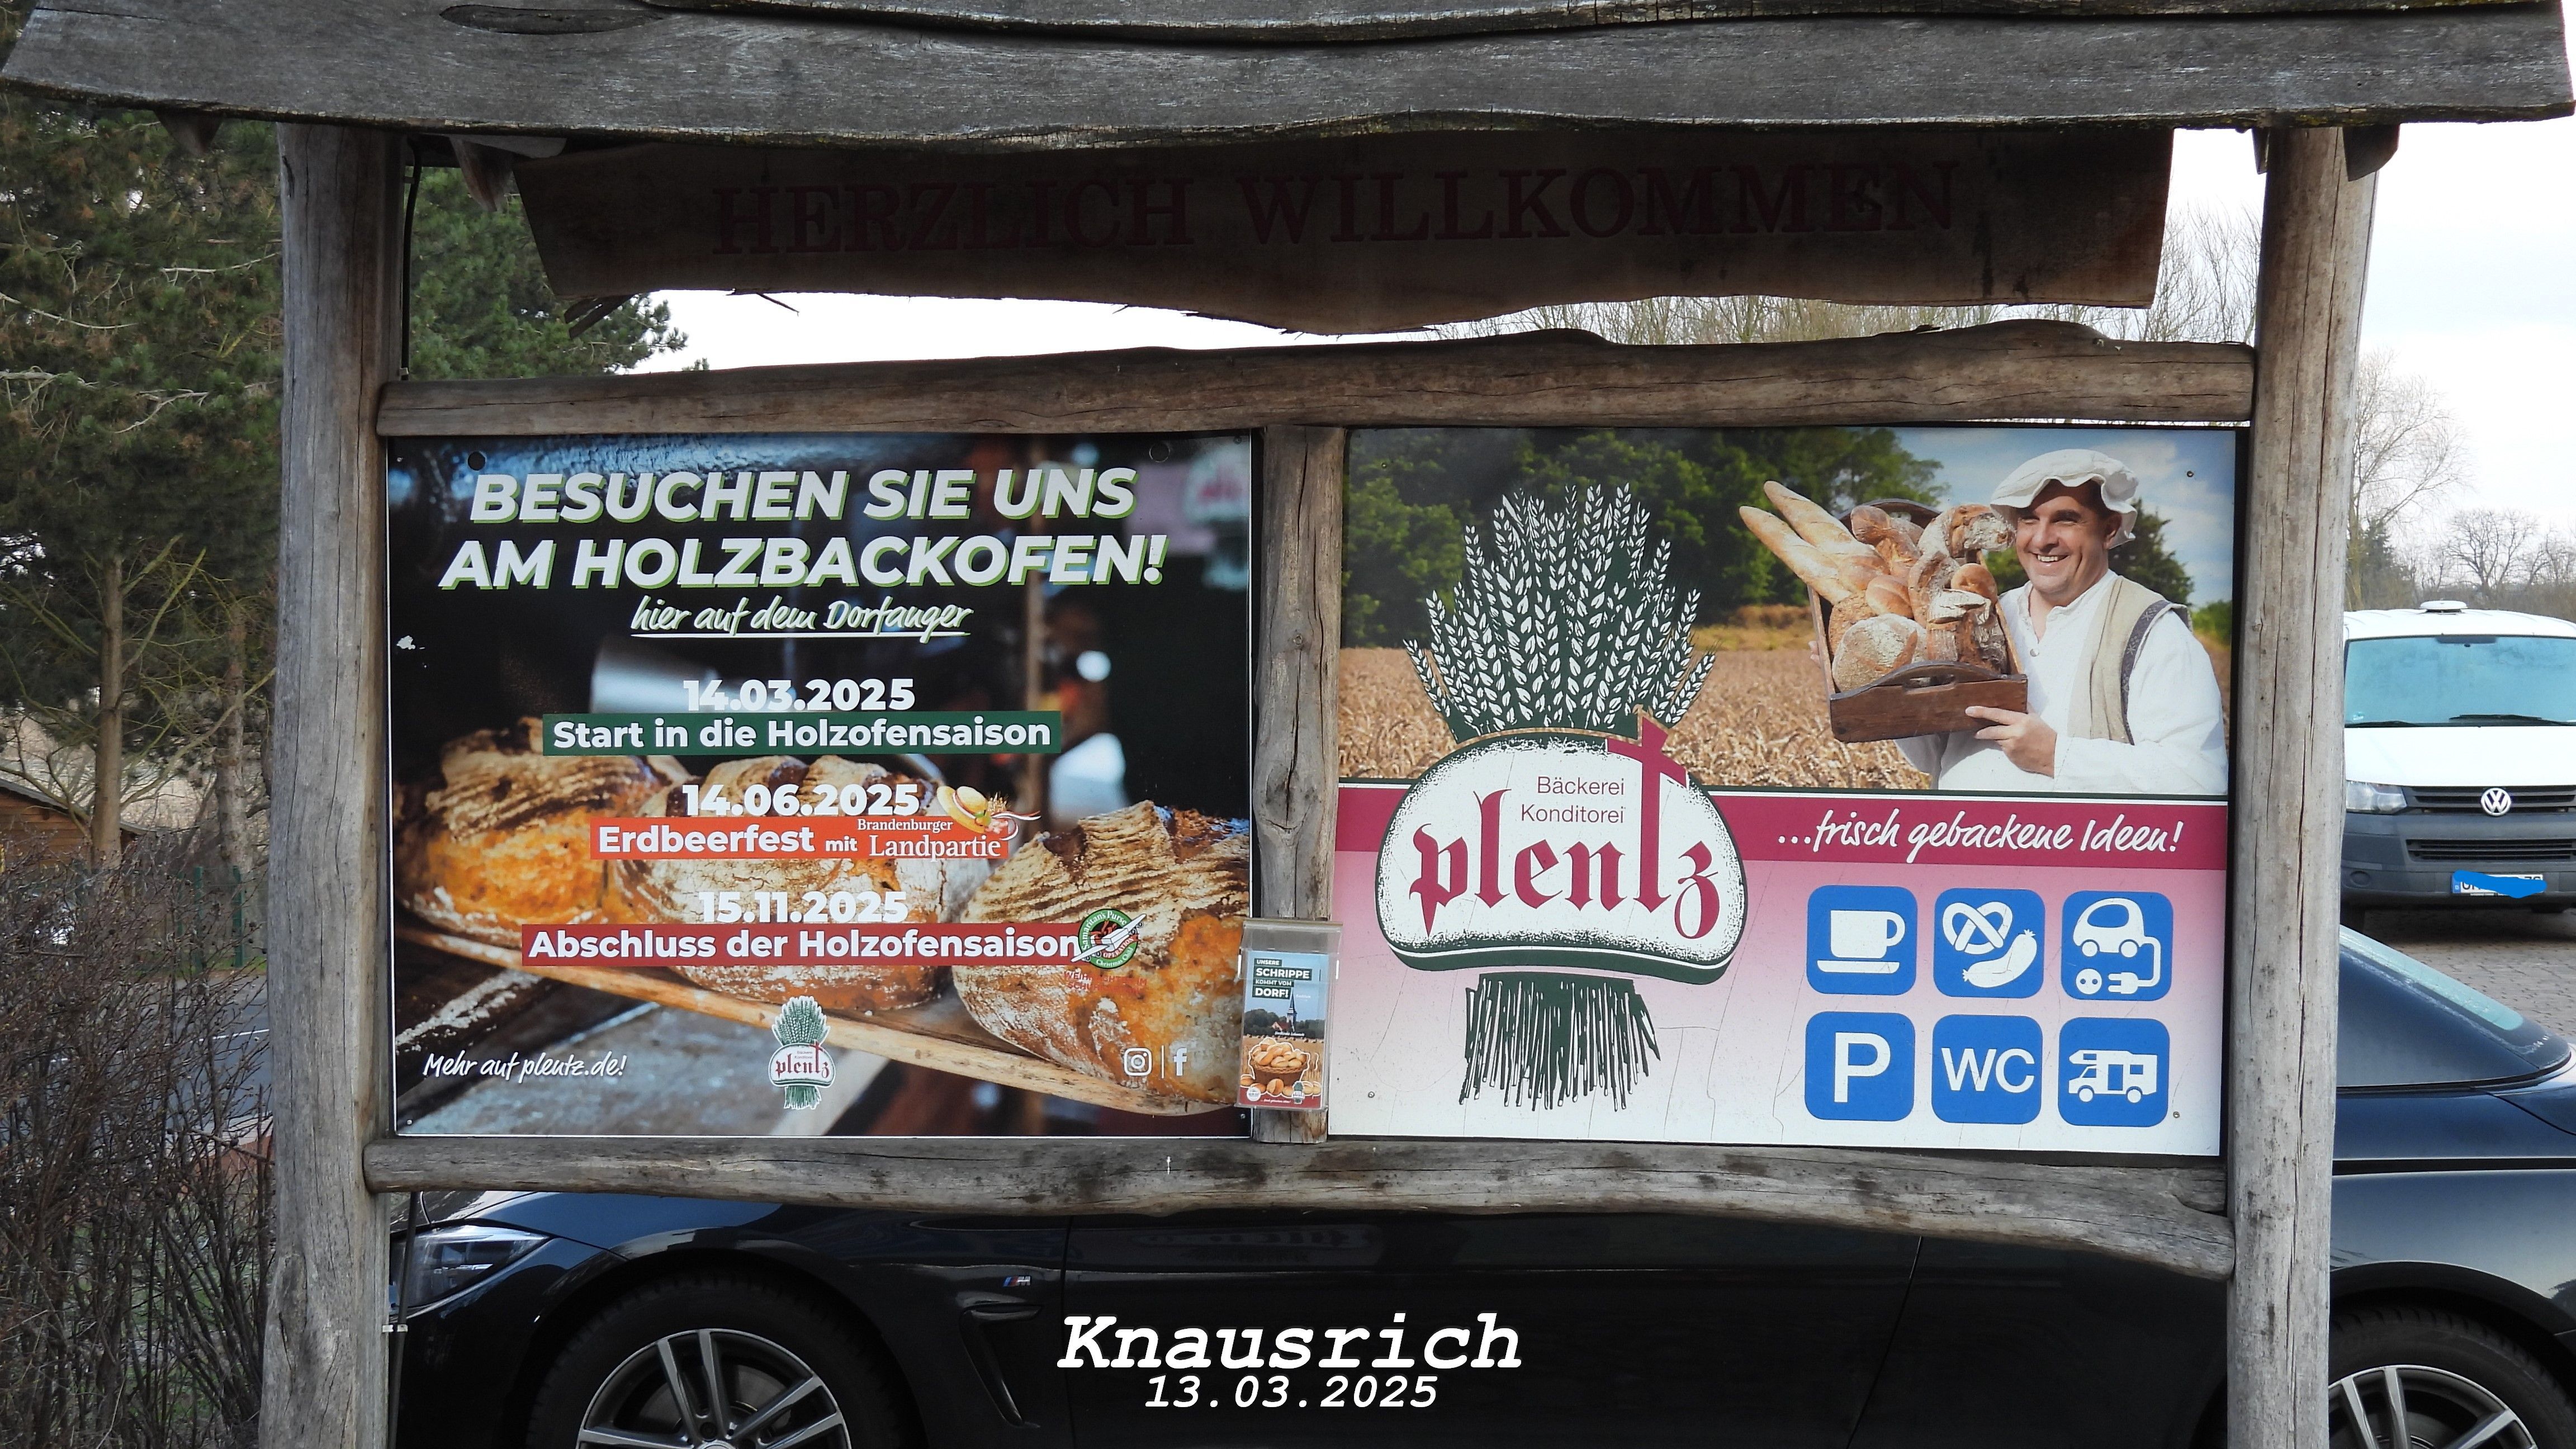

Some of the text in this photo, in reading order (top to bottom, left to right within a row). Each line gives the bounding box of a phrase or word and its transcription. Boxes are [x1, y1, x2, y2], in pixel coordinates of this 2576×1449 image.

[712, 160, 1961, 254] HERZLICH WILLKOMMEN
[470, 467, 1139, 523] BESUCHEN SIE UNS
[438, 534, 1169, 590] AM HOLZBACKOFEN!
[631, 595, 974, 644] hier auf dem Dorfanger
[683, 678, 916, 712] 14.03.2025
[553, 716, 1051, 749] Start in die Holzofensaison
[683, 783, 920, 816] 14.06.2025
[1537, 776, 1625, 795] Bäckerei
[857, 818, 954, 834] Brandenburger
[1409, 716, 1721, 939] plentz
[1521, 803, 1624, 823] Konditorei
[599, 824, 1001, 863] Erdbeerfest mit Landpartie
[1779, 809, 2184, 864] ...frisch gebackene Ideen!
[699, 891, 908, 924] 15.11.2025
[1107, 910, 1128, 926] Purse
[528, 926, 1082, 958] Abschluss der Holzofensaison
[1103, 937, 1135, 958] OPERATION
[1256, 968, 1310, 979] SCHRIPPE
[1255, 987, 1289, 998] DORF!
[423, 1050, 627, 1083] Mehr auf plentz.de!
[775, 1041, 830, 1078] plentz
[1834, 1031, 1891, 1103] P
[1942, 1048, 2035, 1093] WC
